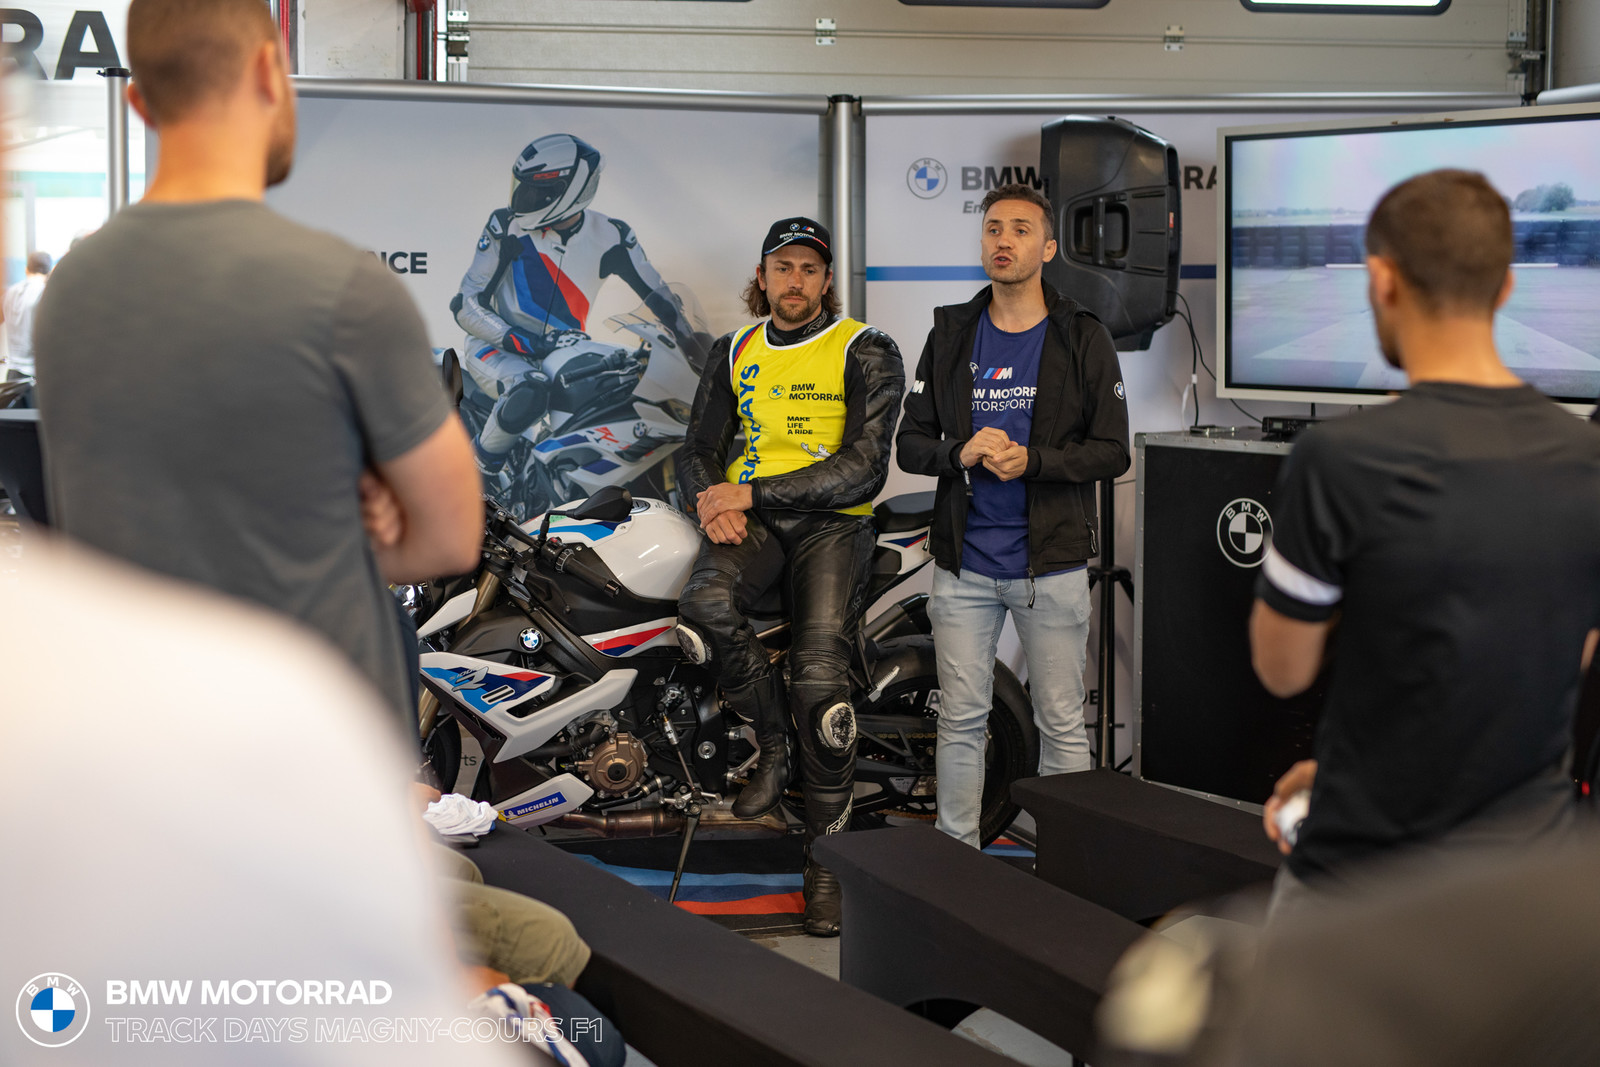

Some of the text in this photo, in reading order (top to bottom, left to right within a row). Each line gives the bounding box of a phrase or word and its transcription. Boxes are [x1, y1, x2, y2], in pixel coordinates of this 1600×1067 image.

[791, 383, 816, 392] BMW
[1225, 501, 1268, 523] BMW
[516, 797, 559, 816] MICHELIN
